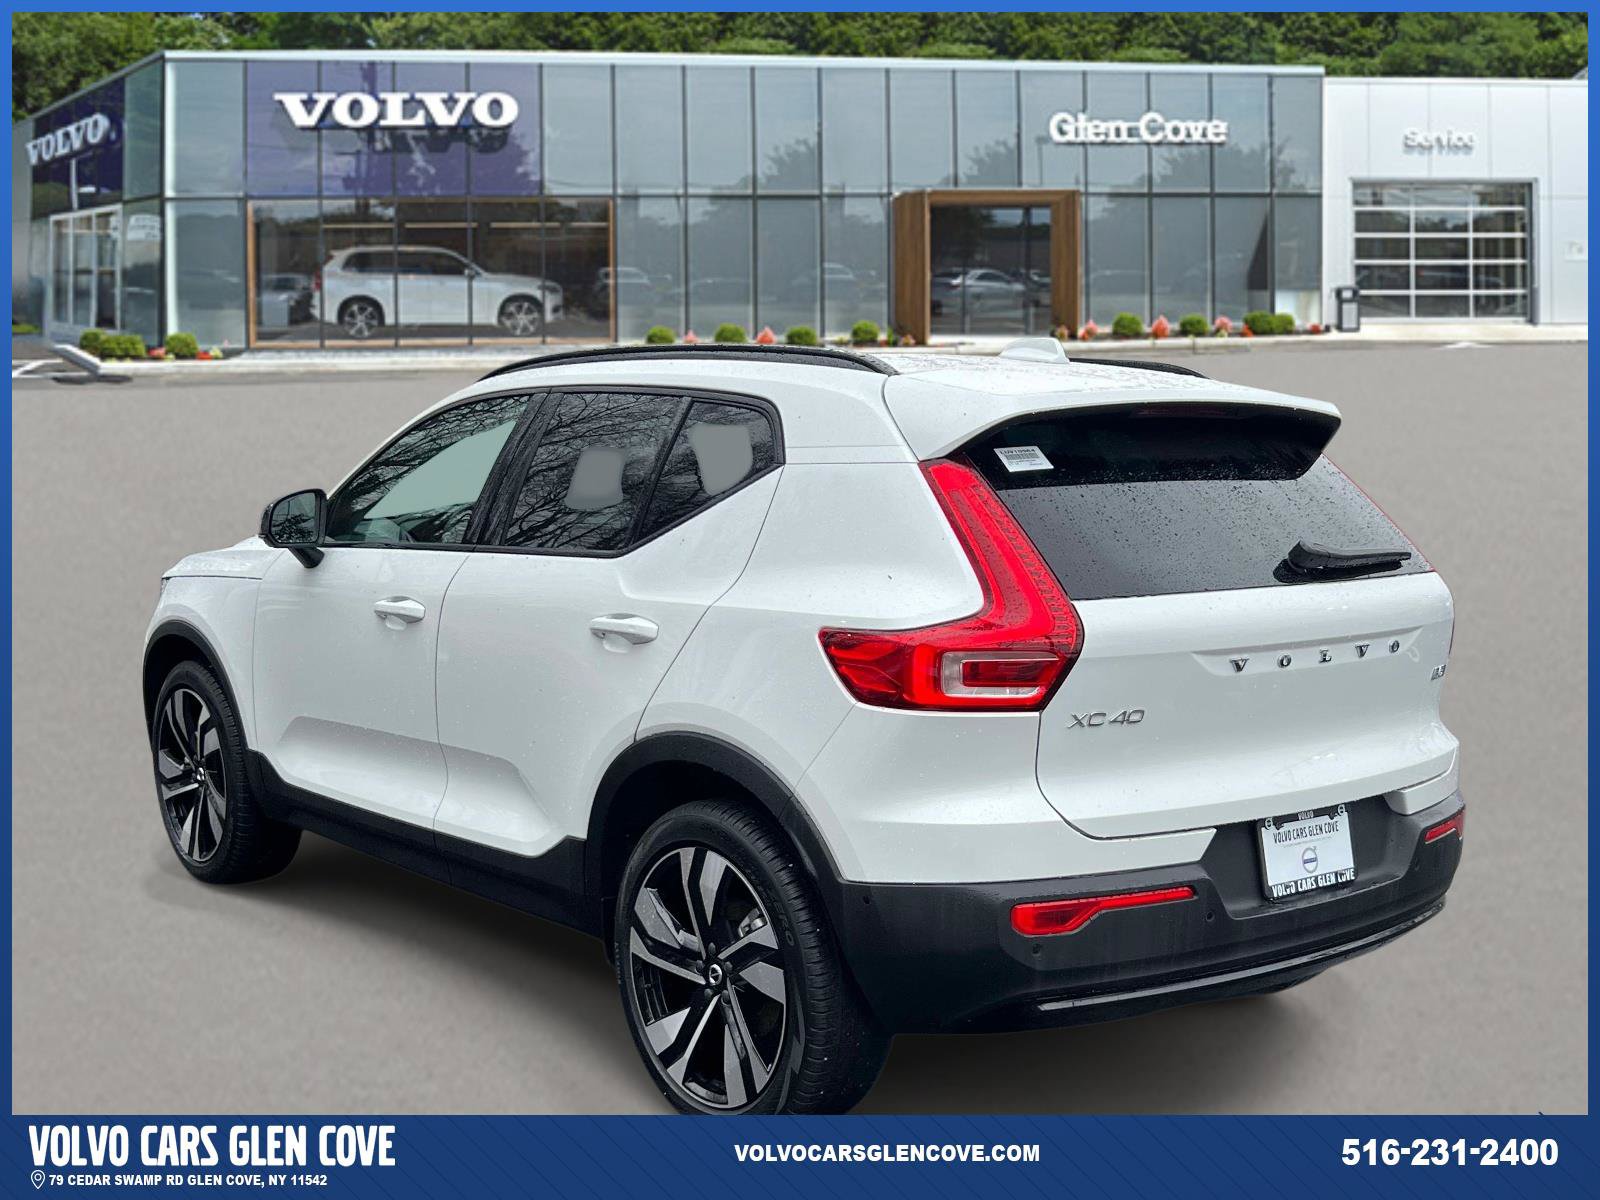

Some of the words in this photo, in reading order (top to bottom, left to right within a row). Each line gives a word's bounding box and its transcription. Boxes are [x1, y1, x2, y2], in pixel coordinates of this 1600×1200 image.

[274, 92, 519, 128] VOLVO
[25, 112, 111, 165] VOLVO
[1049, 112, 1128, 143] Glen
[1139, 112, 1228, 143] Cove
[1229, 638, 1401, 674] VOLVO
[1298, 811, 1314, 820] VOLVO
[1273, 831, 1292, 843] VOLVO
[1293, 826, 1308, 840] CARS
[1308, 823, 1323, 837] GLEN
[1324, 821, 1339, 834] COVE
[1272, 882, 1295, 897] VOLVO
[1298, 876, 1317, 892] CARS
[1318, 871, 1336, 887] GLEN
[1337, 868, 1355, 882] COVE
